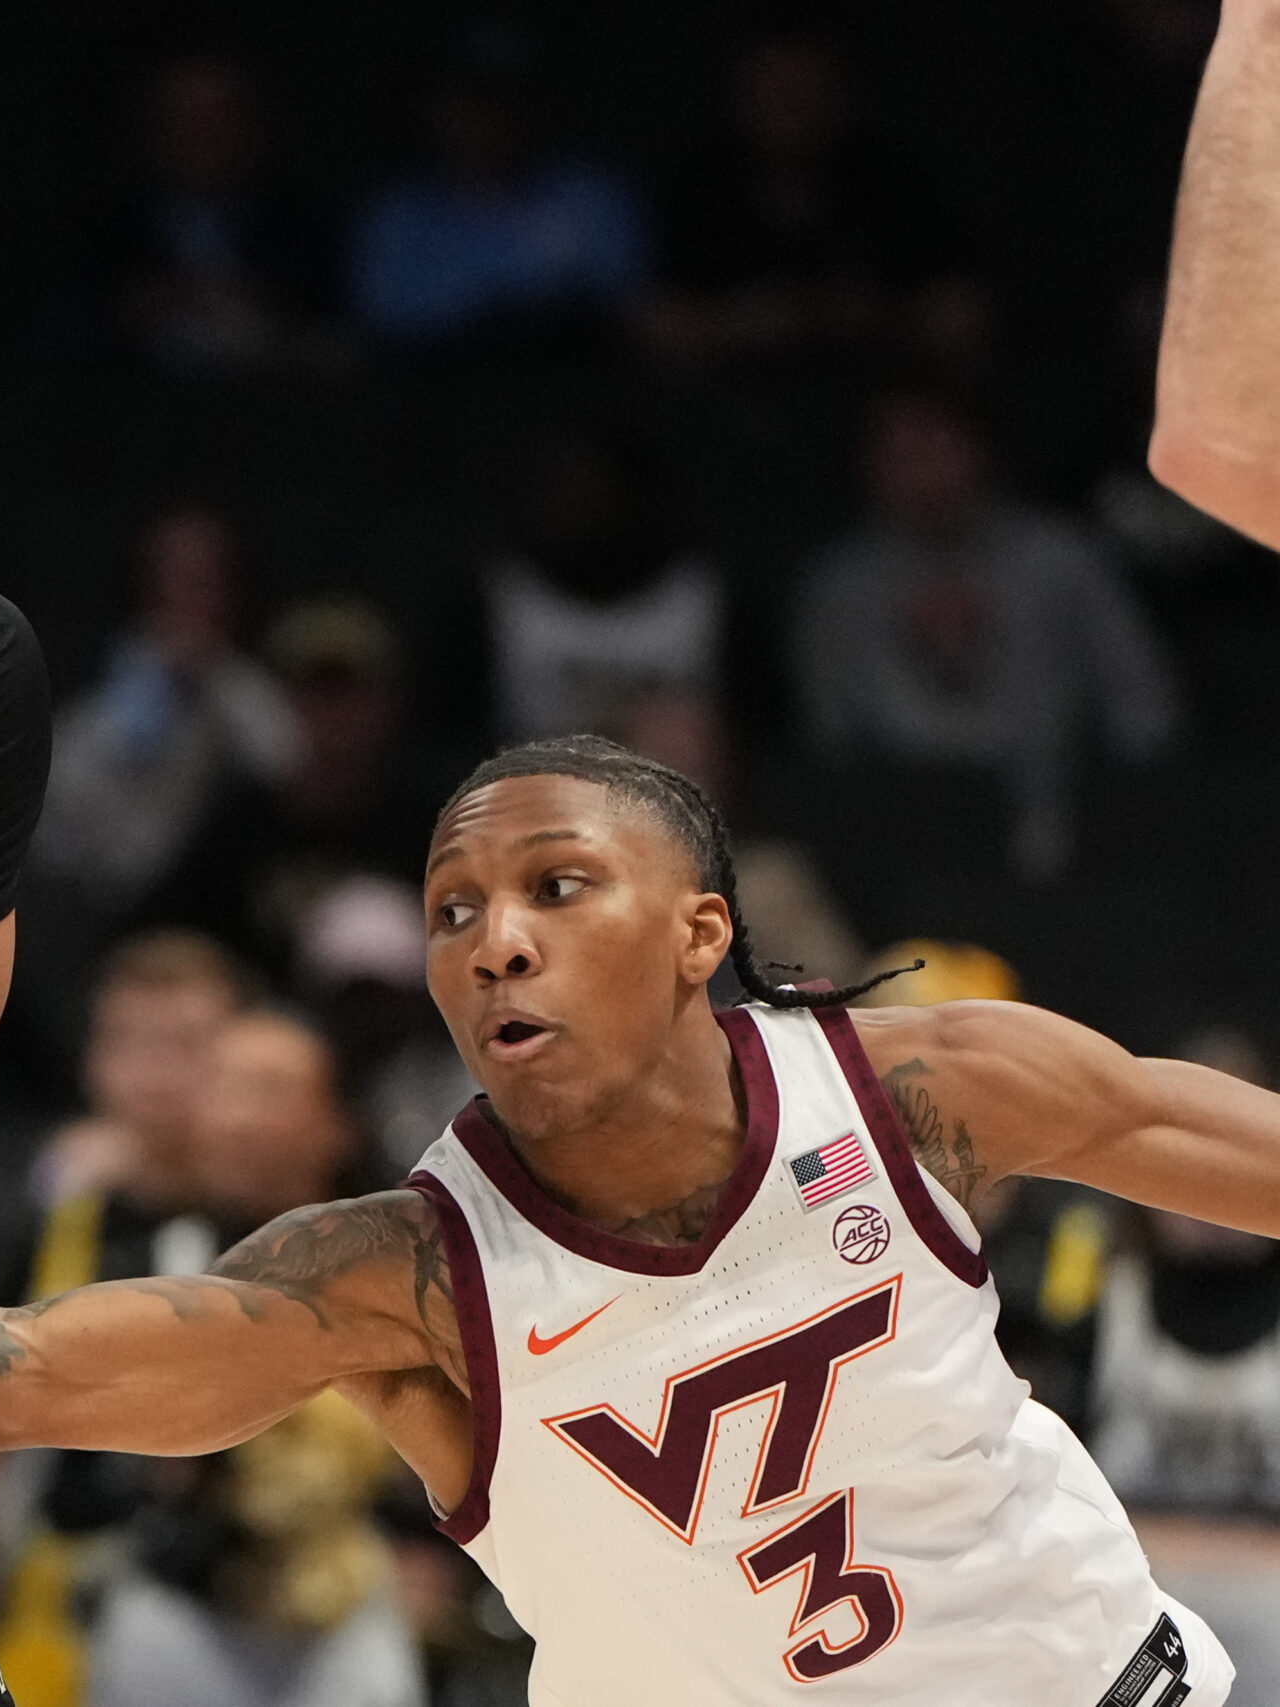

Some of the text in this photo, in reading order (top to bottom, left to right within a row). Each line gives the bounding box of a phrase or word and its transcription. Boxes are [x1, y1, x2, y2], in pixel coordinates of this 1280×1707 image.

[842, 1215, 883, 1246] ACC
[540, 1272, 903, 1545] VT
[736, 1486, 904, 1683] 3
[1113, 1653, 1149, 1699] ENGINEERED
